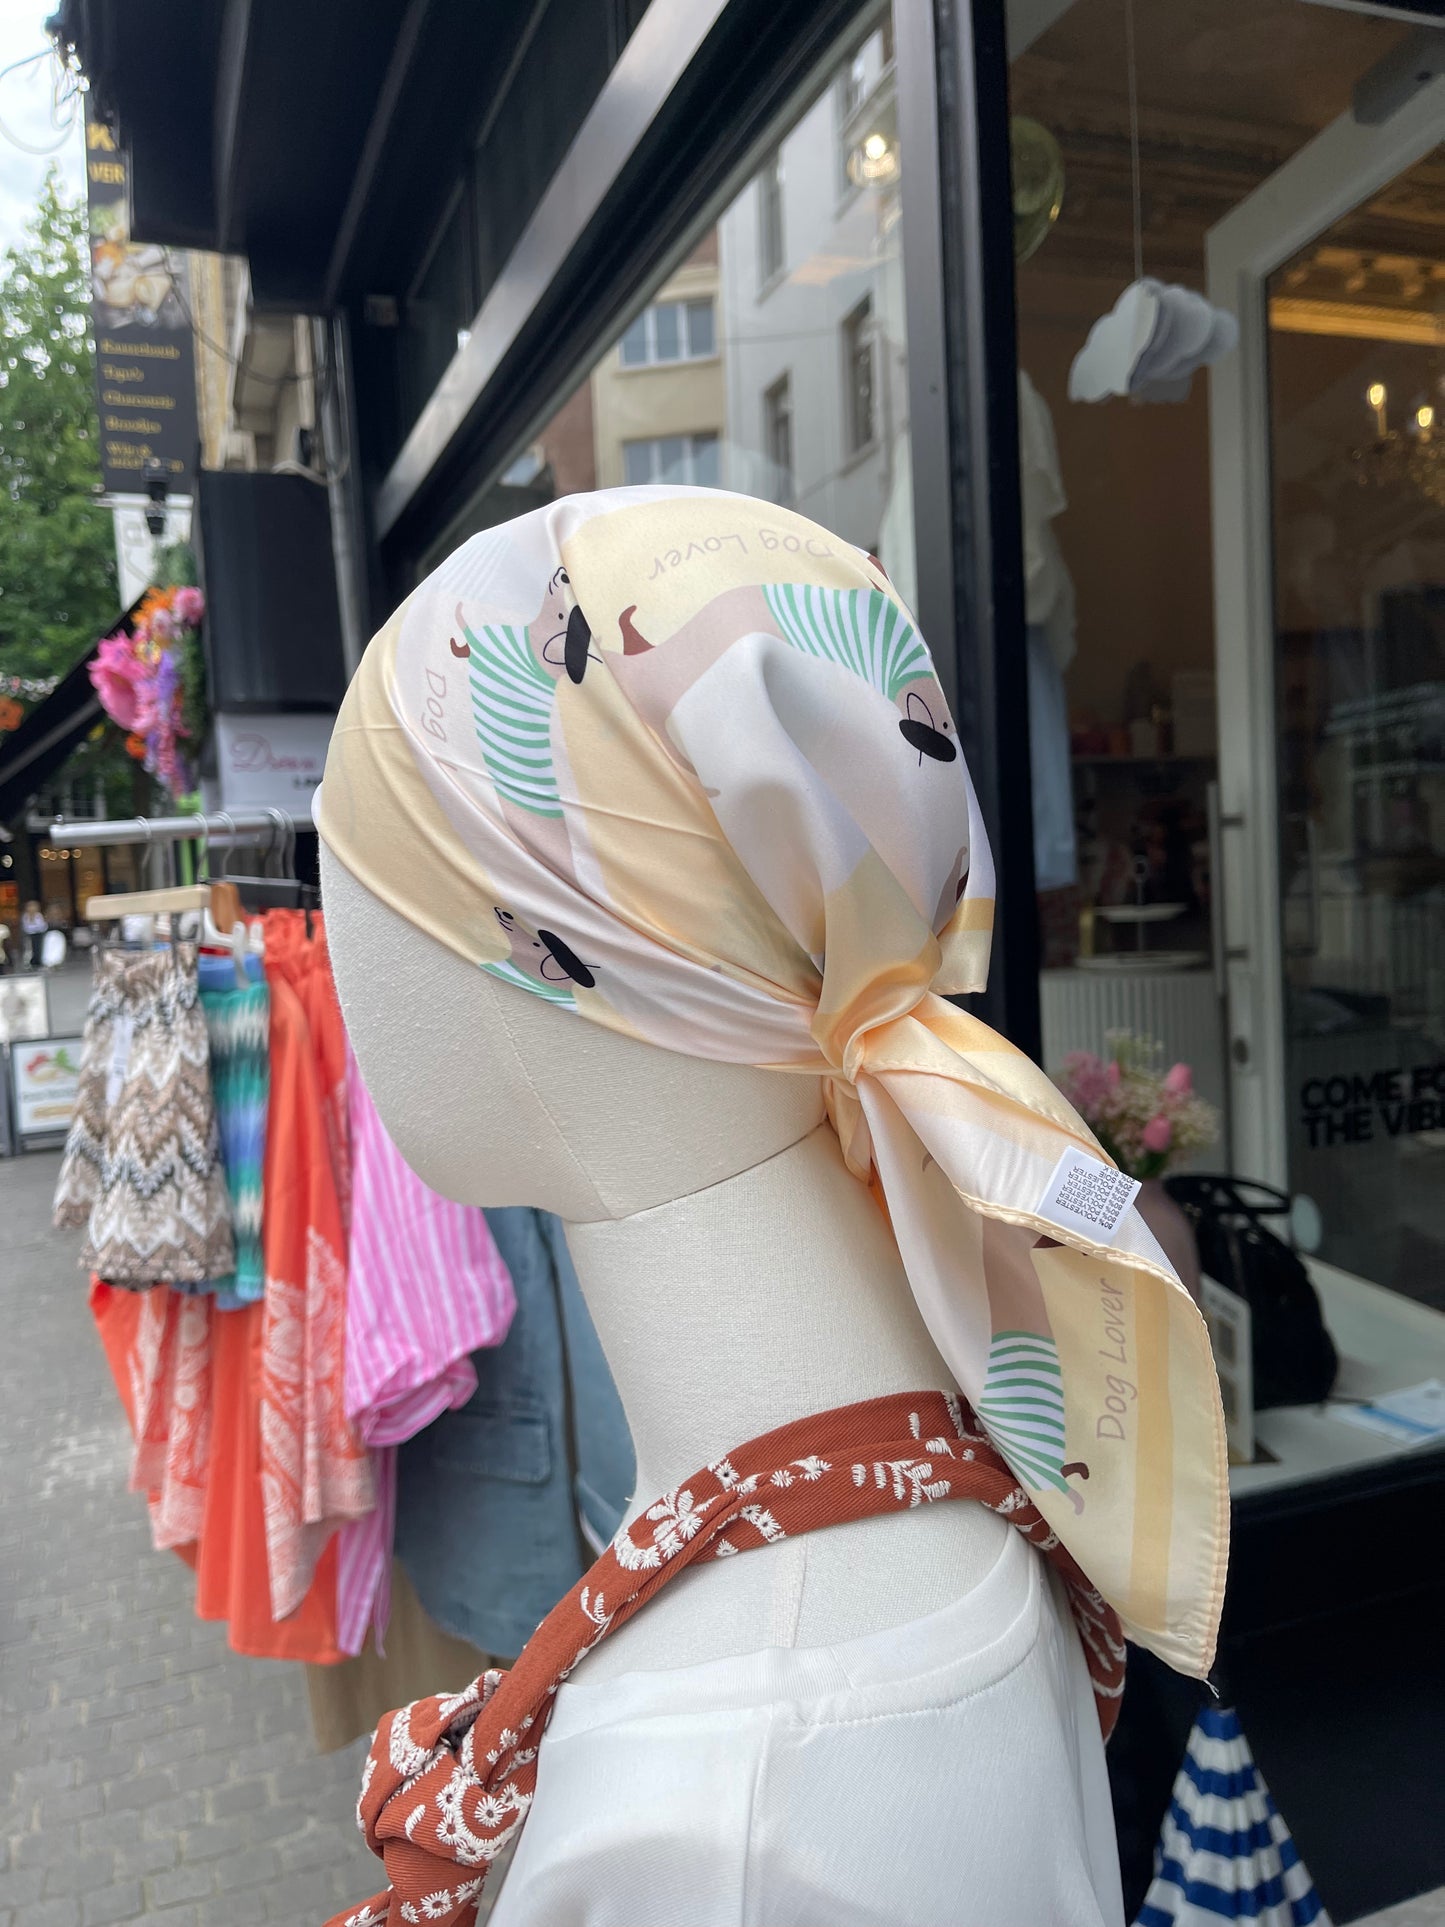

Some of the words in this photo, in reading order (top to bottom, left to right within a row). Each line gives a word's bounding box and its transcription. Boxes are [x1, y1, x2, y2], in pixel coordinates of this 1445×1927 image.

[648, 534, 749, 581] Lover
[758, 528, 835, 558] Dog
[421, 666, 447, 743] Dog
[1301, 1069, 1403, 1111] COME
[1302, 1108, 1375, 1148] THE
[1067, 1171, 1110, 1196] POLYESTER
[1099, 1171, 1116, 1183] SOIE
[1103, 1165, 1119, 1177] SILK
[1055, 1196, 1097, 1222] POLYESTER
[1058, 1190, 1101, 1215] POLYESTER
[1061, 1184, 1104, 1209] POLYESTER
[1099, 1278, 1128, 1364] Lover
[1096, 1374, 1138, 1440] Dog
